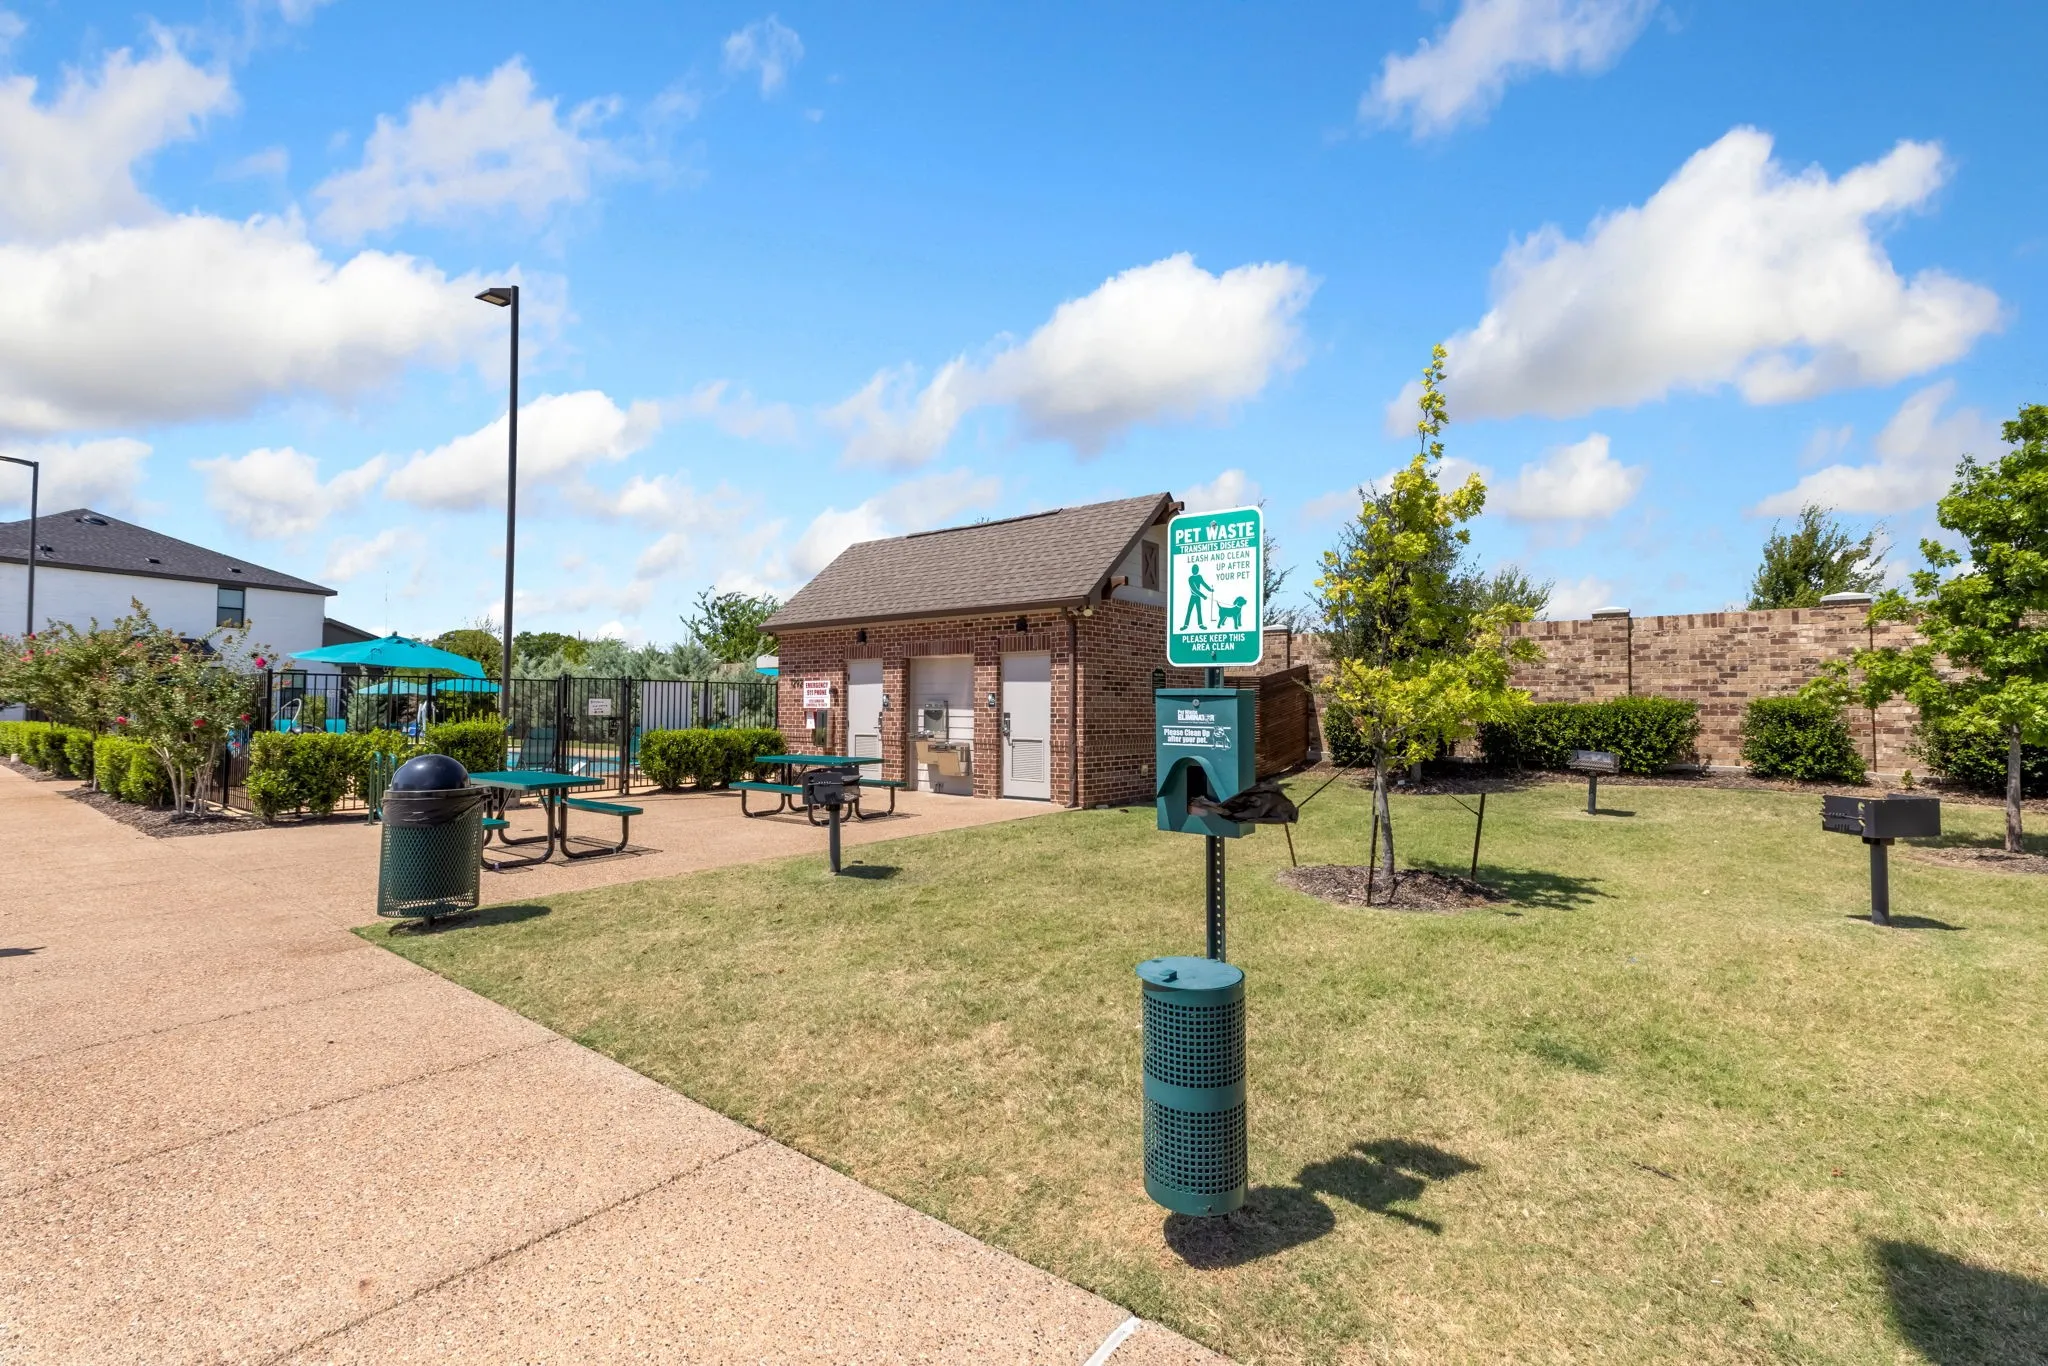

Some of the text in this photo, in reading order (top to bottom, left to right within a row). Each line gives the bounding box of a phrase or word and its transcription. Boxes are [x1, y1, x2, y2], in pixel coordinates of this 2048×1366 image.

[1176, 521, 1255, 544] PET WASTE
[1181, 540, 1249, 553] TRANSMITS DISEASE
[1187, 550, 1250, 564] LEASH AND CLEAN
[1216, 561, 1250, 571] UP AFTER
[1216, 571, 1250, 581] YOUR PET
[1182, 633, 1246, 643] PLEASE KEEP THIS
[1192, 642, 1235, 652] AREA CLEAN
[1163, 728, 1183, 736] Please
[1201, 729, 1211, 738] Up
[1167, 735, 1208, 744] after your pet.
